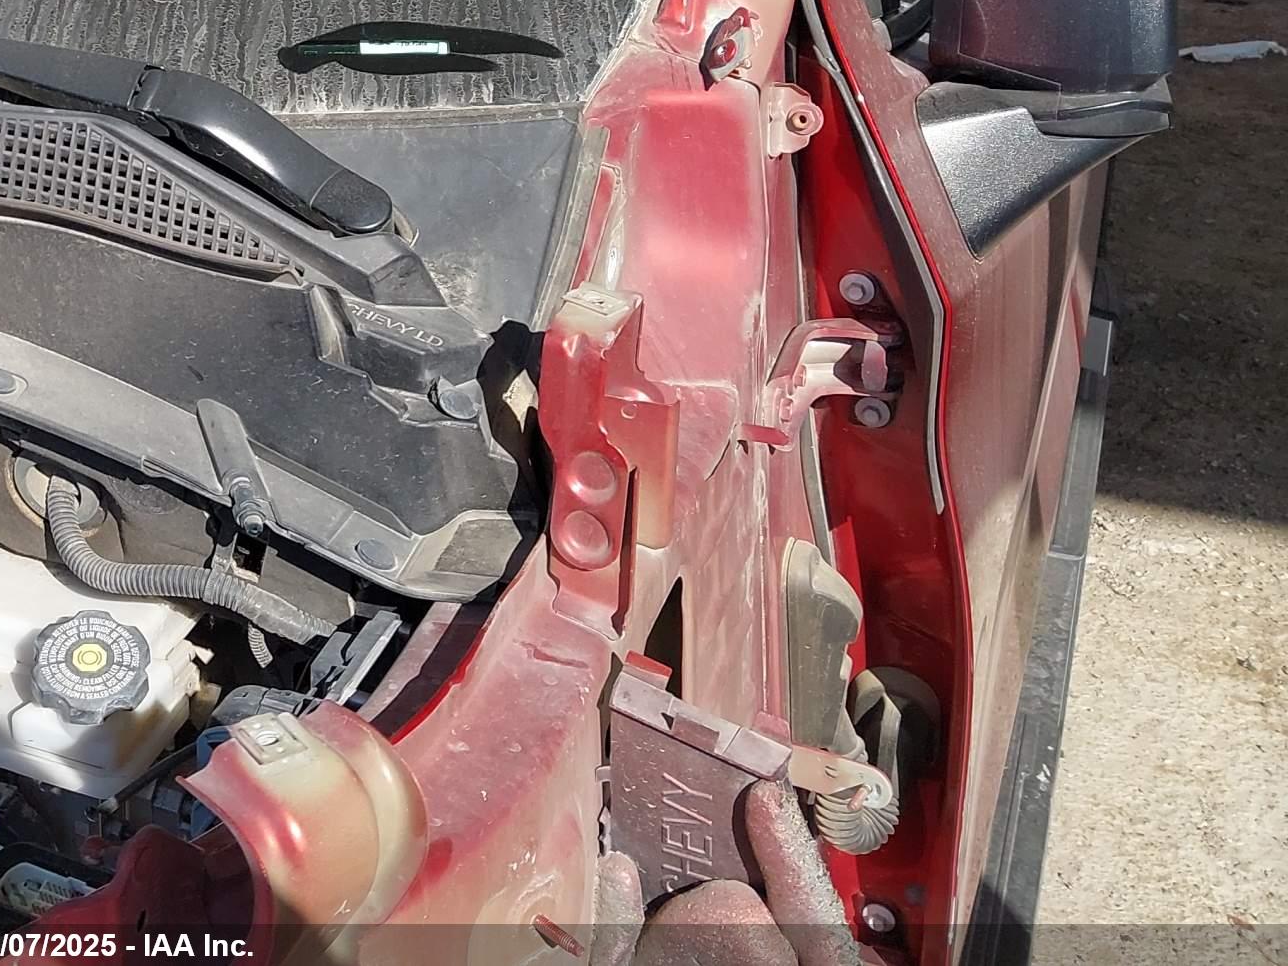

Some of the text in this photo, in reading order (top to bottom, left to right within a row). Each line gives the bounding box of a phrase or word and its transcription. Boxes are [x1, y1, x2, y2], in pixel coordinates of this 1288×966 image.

[346, 302, 444, 347] CHEVY LD
[83, 677, 104, 685] CLEAN
[102, 665, 120, 682] FILLER
